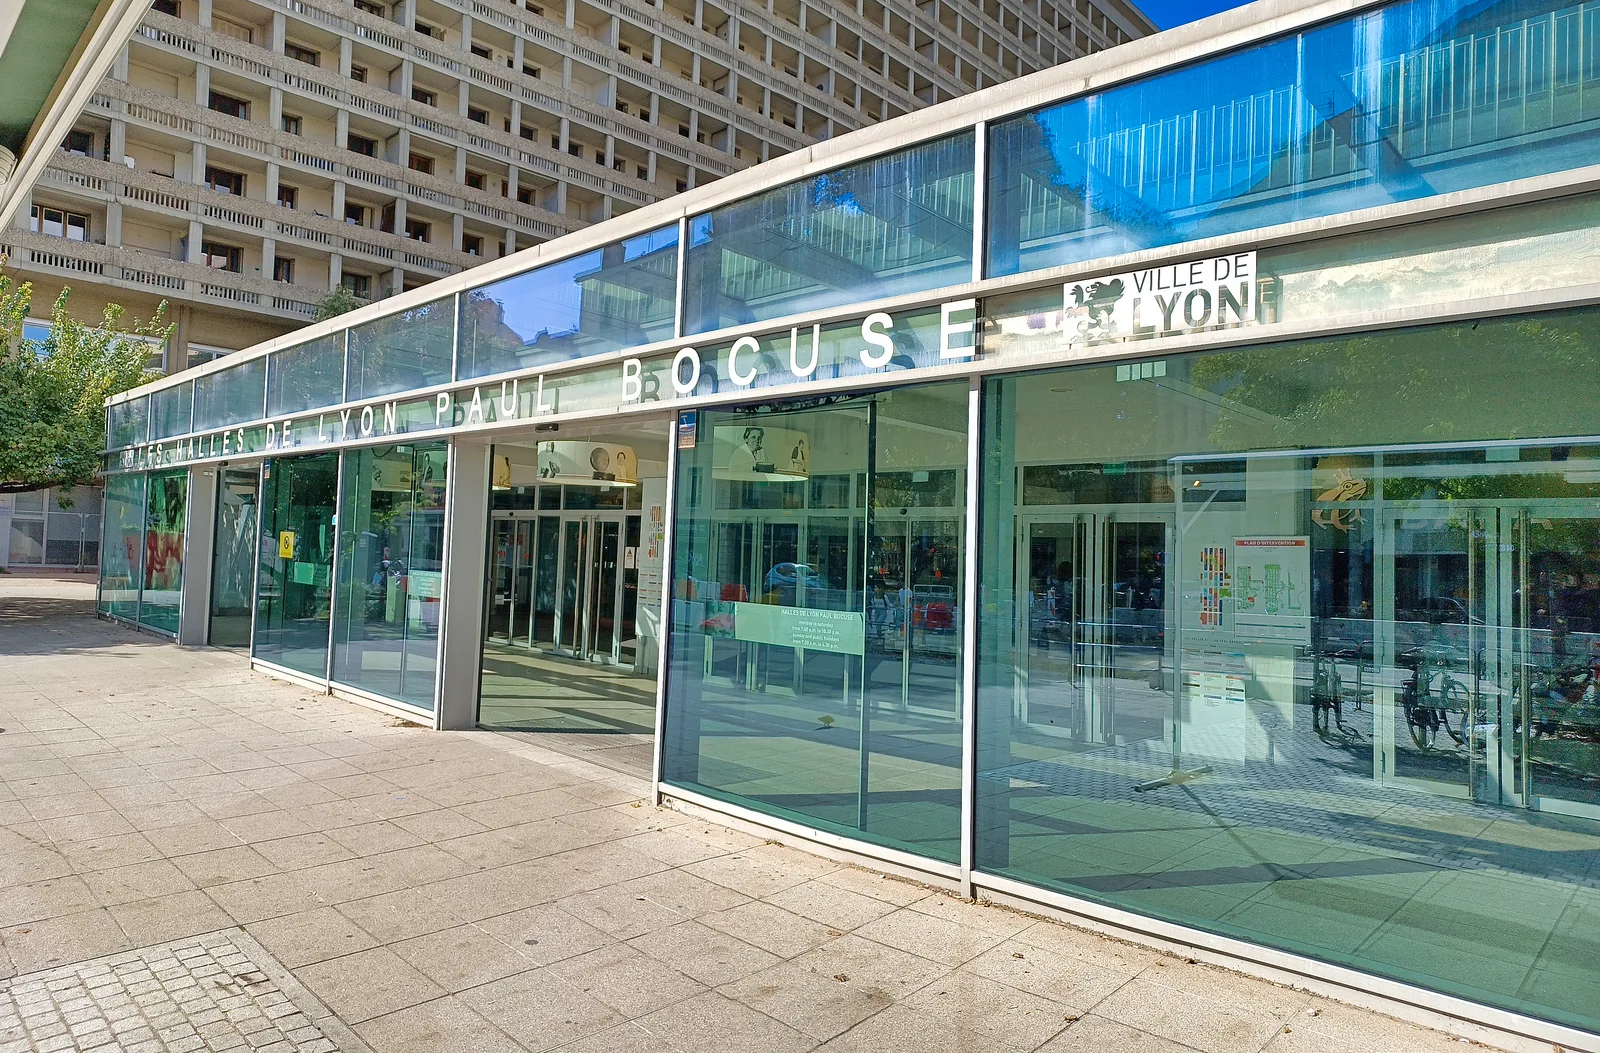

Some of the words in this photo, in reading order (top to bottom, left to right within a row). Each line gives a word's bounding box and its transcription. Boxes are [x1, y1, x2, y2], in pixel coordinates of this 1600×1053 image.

[1133, 262, 1204, 293] VILLE
[1214, 254, 1249, 281] DE
[1133, 281, 1249, 335] LYON
[176, 428, 244, 461] HALLES
[266, 420, 292, 449] DE
[318, 402, 397, 441] LYON
[435, 375, 551, 426] PAUL
[622, 298, 976, 401] BOCUSE
[780, 608, 799, 616] HALLES
[834, 613, 854, 621] BOCUSE
